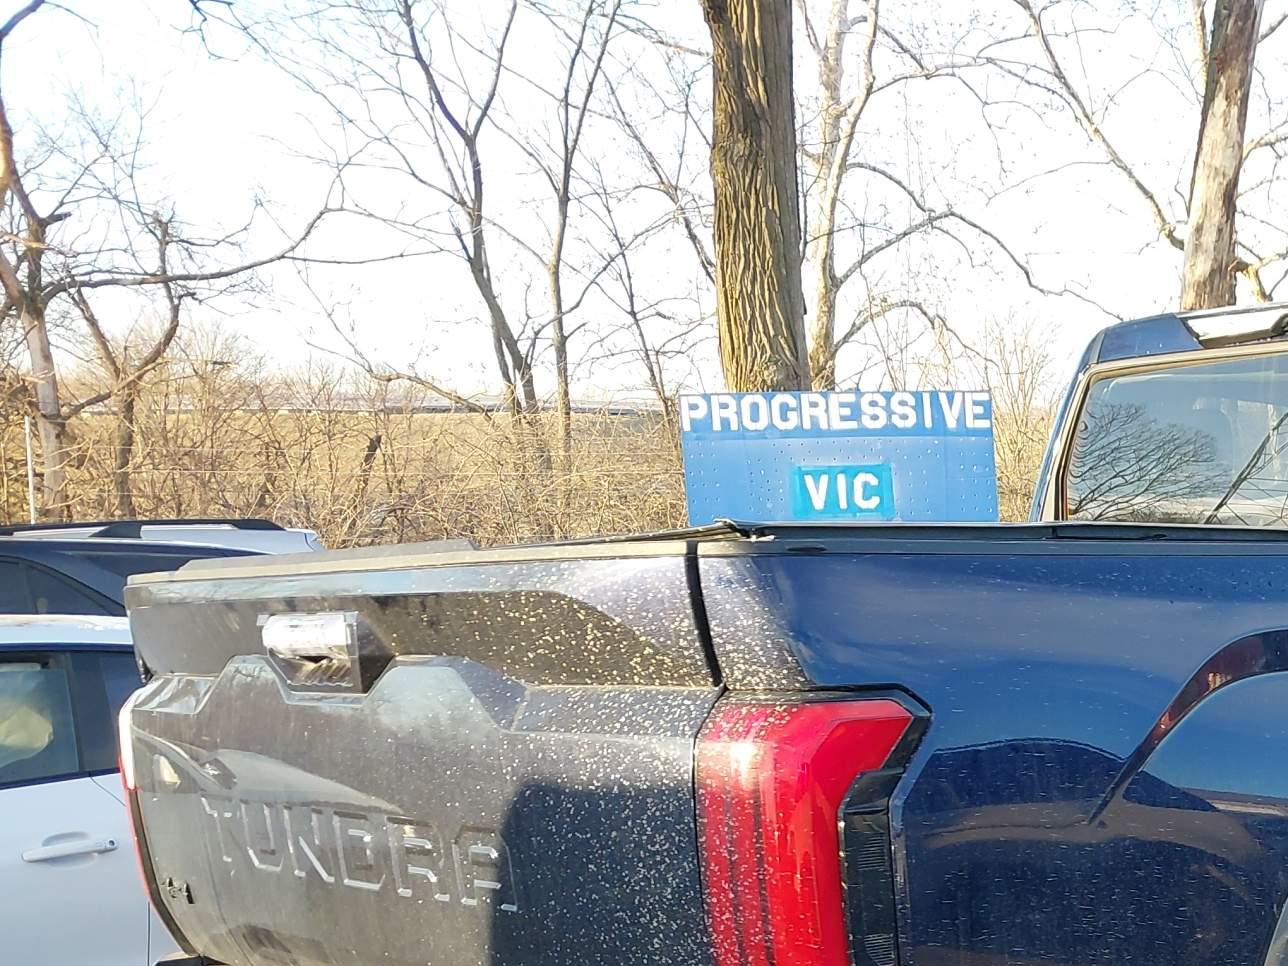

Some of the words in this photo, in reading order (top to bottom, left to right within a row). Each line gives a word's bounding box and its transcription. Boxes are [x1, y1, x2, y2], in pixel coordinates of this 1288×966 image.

[682, 391, 992, 432] PROGRESSIVE
[804, 471, 880, 511] VIC
[199, 796, 519, 913] TUNDRA
